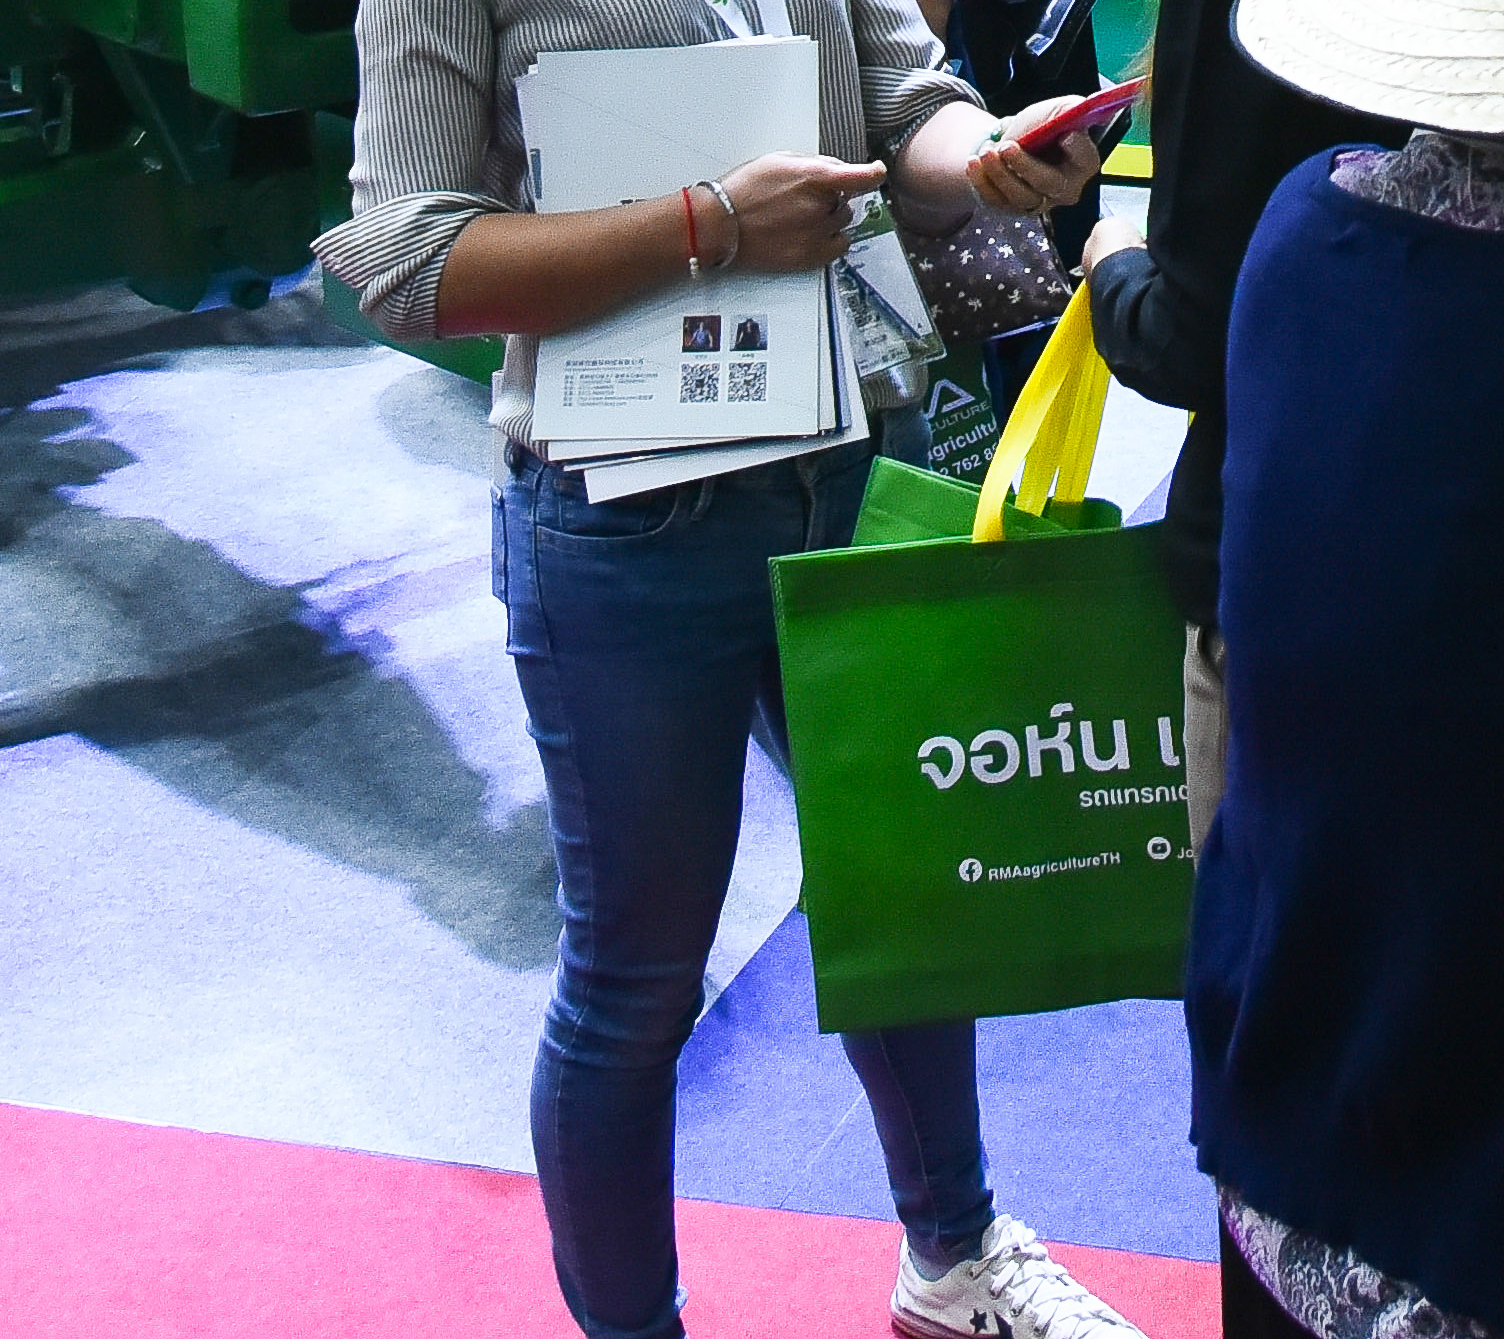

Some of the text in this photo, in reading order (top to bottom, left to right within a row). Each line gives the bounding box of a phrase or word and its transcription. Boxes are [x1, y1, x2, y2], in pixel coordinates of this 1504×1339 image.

[953, 455, 981, 476] 762
[918, 703, 1131, 790] จอห์น
[988, 852, 1121, 881] RMAagricultureTH
